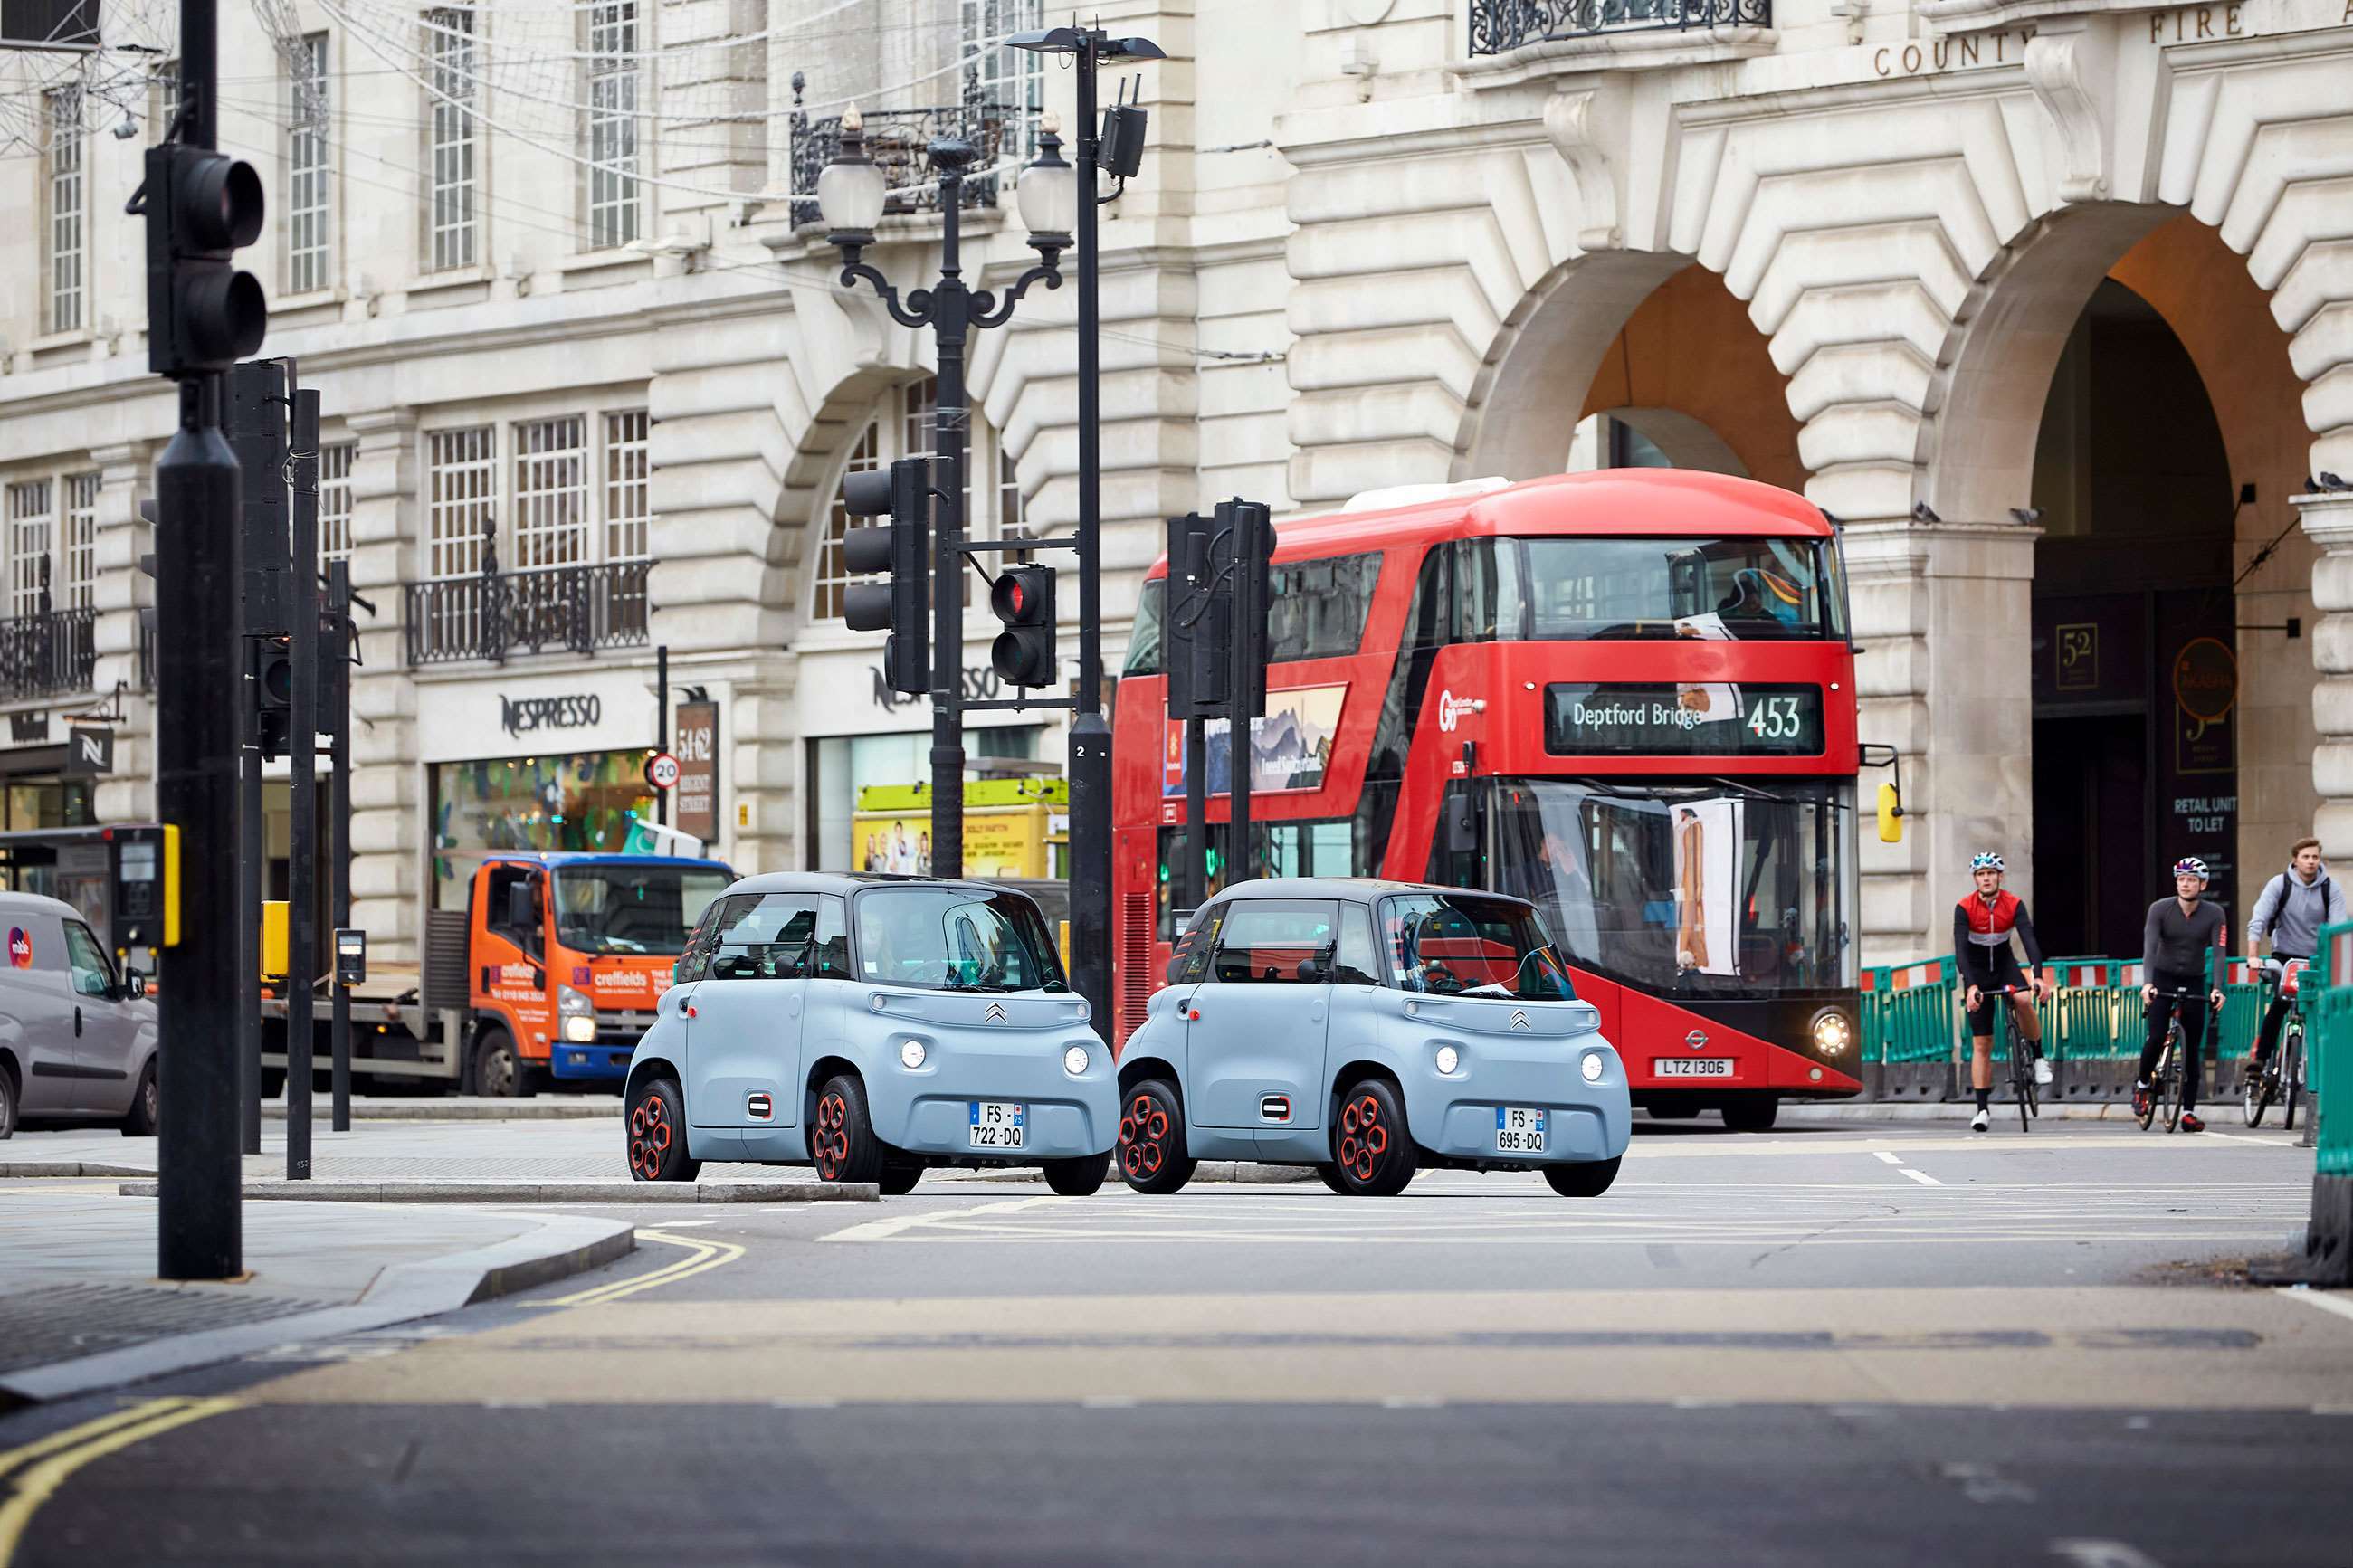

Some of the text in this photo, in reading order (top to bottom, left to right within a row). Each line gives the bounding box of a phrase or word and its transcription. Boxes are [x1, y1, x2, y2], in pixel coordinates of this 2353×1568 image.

[2149, 4, 2244, 43] FIRE
[2063, 631, 2091, 667] 52
[500, 694, 601, 739] NESPRESSO
[1574, 702, 1703, 731] Deptford Bridge
[1747, 697, 1801, 738] 453
[1076, 746, 1085, 757] 2
[656, 764, 677, 778] 20
[2174, 796, 2237, 813] RETAIL UNIT
[2187, 816, 2224, 833] TO LET
[1014, 1116, 1022, 1124] 75
[1536, 1121, 1544, 1129] 75
